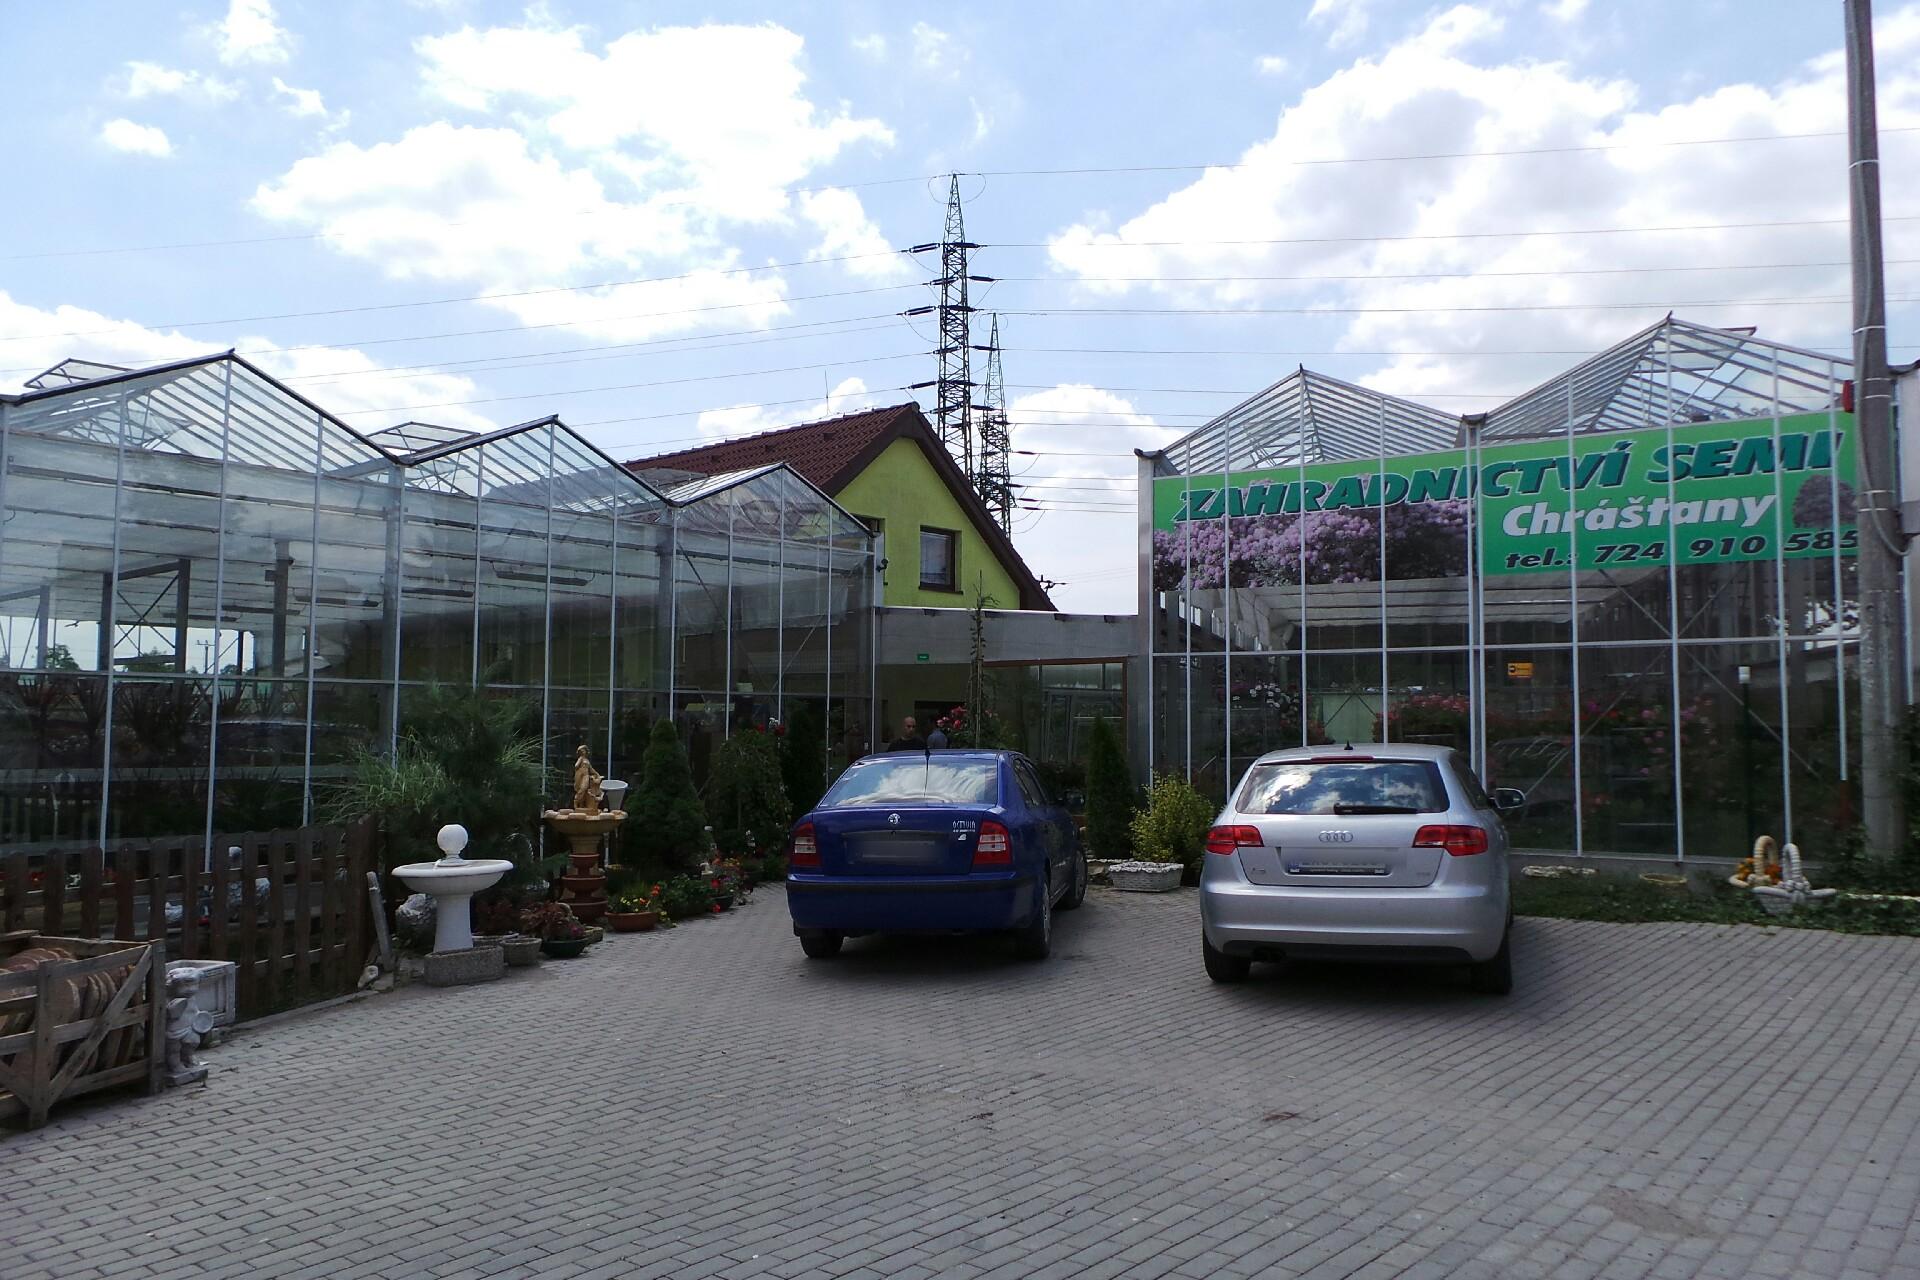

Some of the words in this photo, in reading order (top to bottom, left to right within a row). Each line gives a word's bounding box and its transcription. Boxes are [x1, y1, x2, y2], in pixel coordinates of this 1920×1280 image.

[1171, 440, 1637, 523] ZAHRADNICTVÍ
[1646, 429, 1842, 483] SEMI
[1594, 542, 1665, 564] 724
[1689, 535, 1767, 558] 910
[1783, 528, 1859, 552] 585
